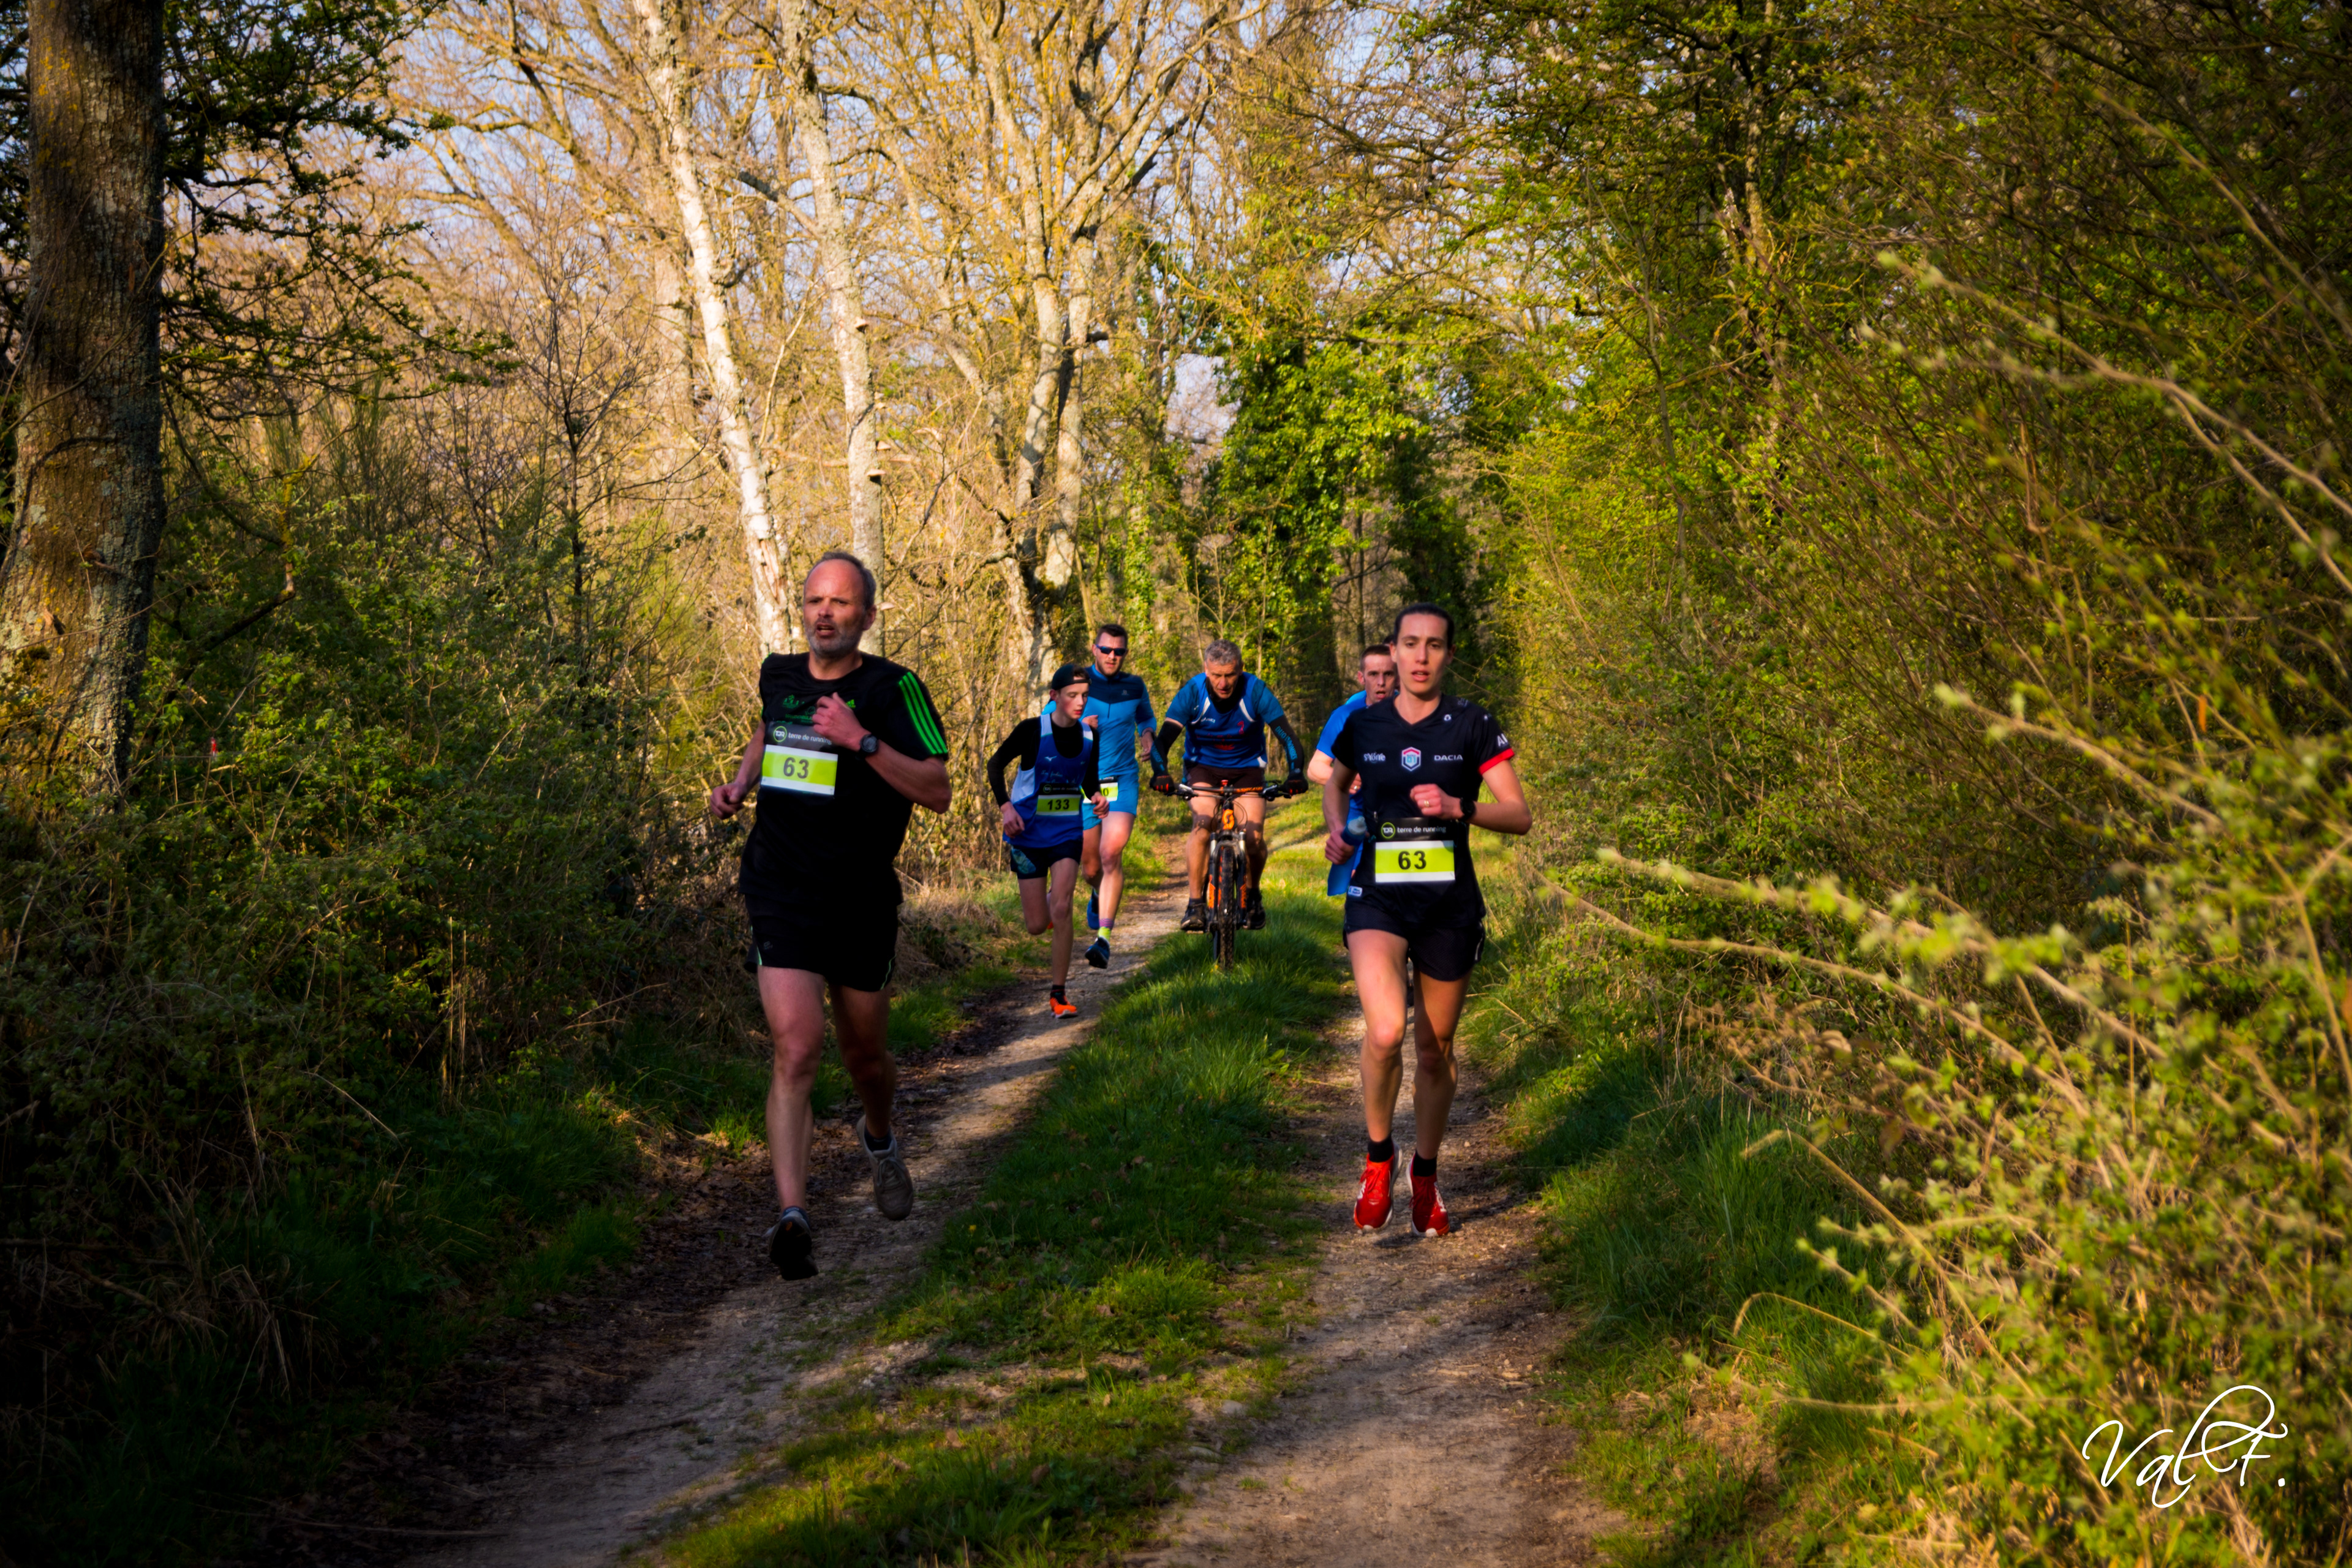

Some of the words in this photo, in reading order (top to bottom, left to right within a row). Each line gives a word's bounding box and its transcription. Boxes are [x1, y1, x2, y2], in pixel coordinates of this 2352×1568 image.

[783, 757, 809, 779] 63
[1047, 799, 1069, 810] 133
[1398, 850, 1427, 870] 63
